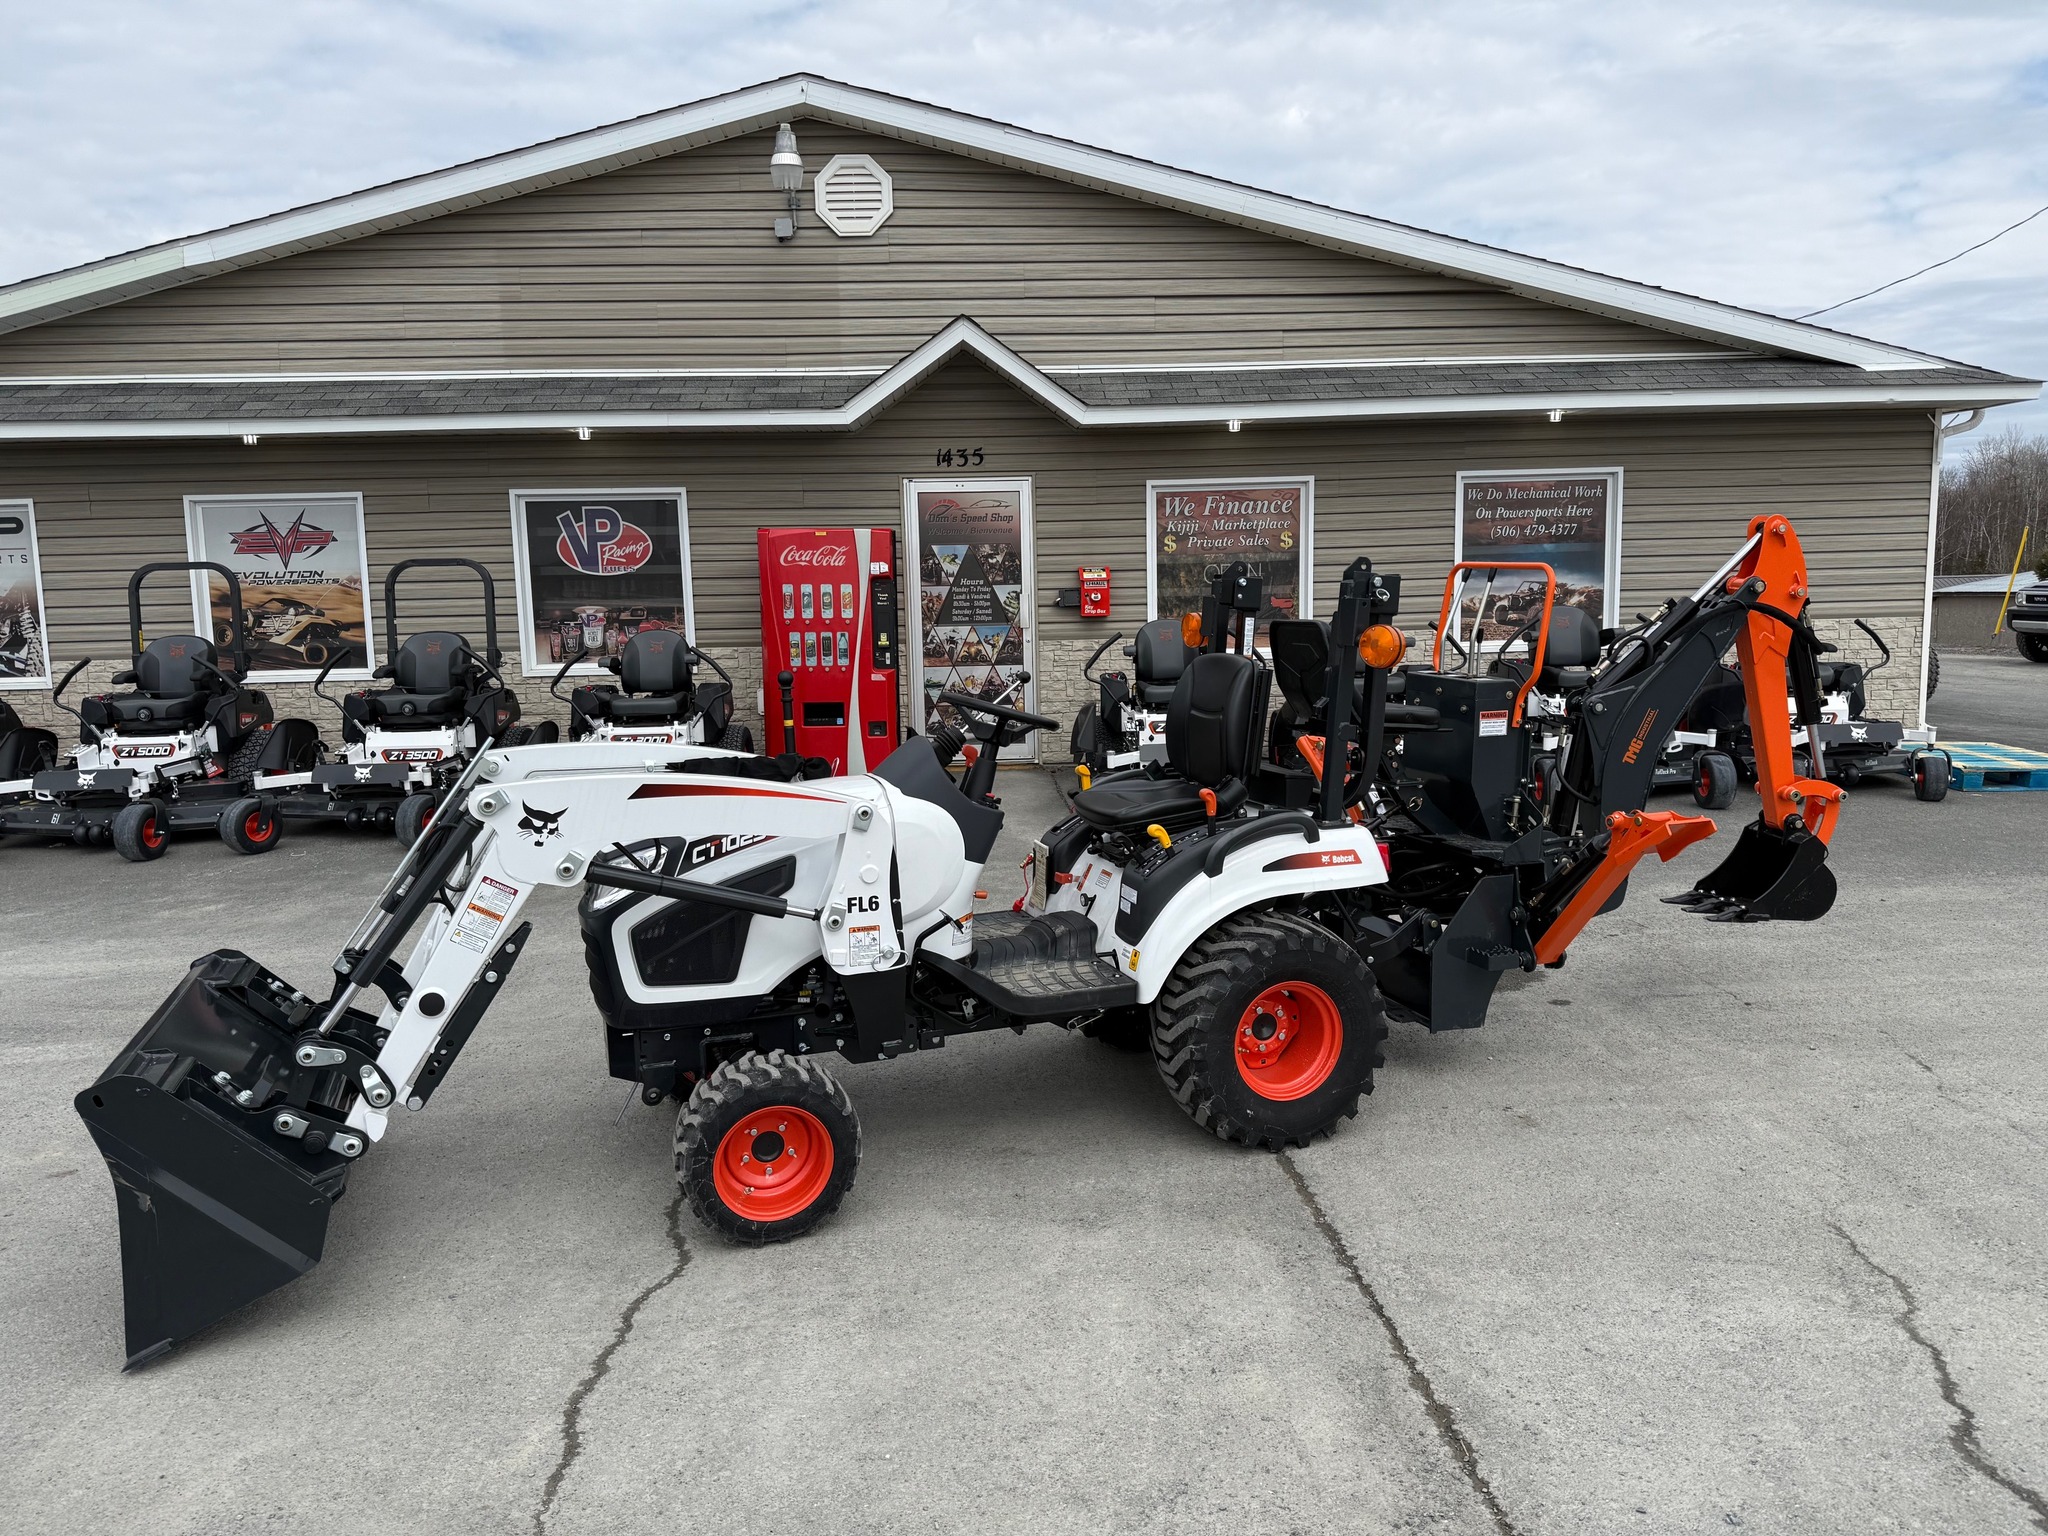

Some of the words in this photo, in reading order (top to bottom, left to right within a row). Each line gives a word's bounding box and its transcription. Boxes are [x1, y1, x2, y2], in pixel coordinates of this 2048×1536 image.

[937, 447, 984, 467] 1435
[1468, 488, 1483, 500] We
[1487, 488, 1502, 500] Do
[1505, 486, 1571, 500] Mechanical
[1575, 485, 1603, 498] Work
[1164, 496, 1196, 517] We
[1202, 495, 1293, 516] Finance
[1475, 507, 1492, 520] On
[1496, 505, 1563, 521] Powersports
[1566, 504, 1593, 517] Here
[960, 513, 988, 524] Speed
[990, 512, 1014, 524] Shop
[928, 527, 963, 536] Welcome
[1166, 520, 1200, 536] Kijiji
[1202, 519, 1209, 532] /
[1211, 518, 1291, 534] Marketplace
[1490, 524, 1521, 539] (506)
[1524, 523, 1578, 536] 479-4377
[556, 506, 623, 574] VP
[1187, 536, 1234, 548] Private
[1238, 534, 1270, 547] Sales
[603, 540, 650, 565] Racing
[233, 570, 325, 580] EVOLUTION
[603, 565, 637, 573] FUELS
[248, 577, 341, 586] POWERSPORTS
[960, 578, 984, 586] Hours
[1481, 711, 1507, 719] WARNING
[120, 746, 171, 757] ZT5000
[389, 751, 438, 761] ZT3500
[1622, 737, 1644, 764] TMG
[51, 813, 61, 824] 61
[1332, 855, 1355, 863] Bobcat
[491, 881, 515, 894] DANGER
[847, 895, 880, 914] FL6
